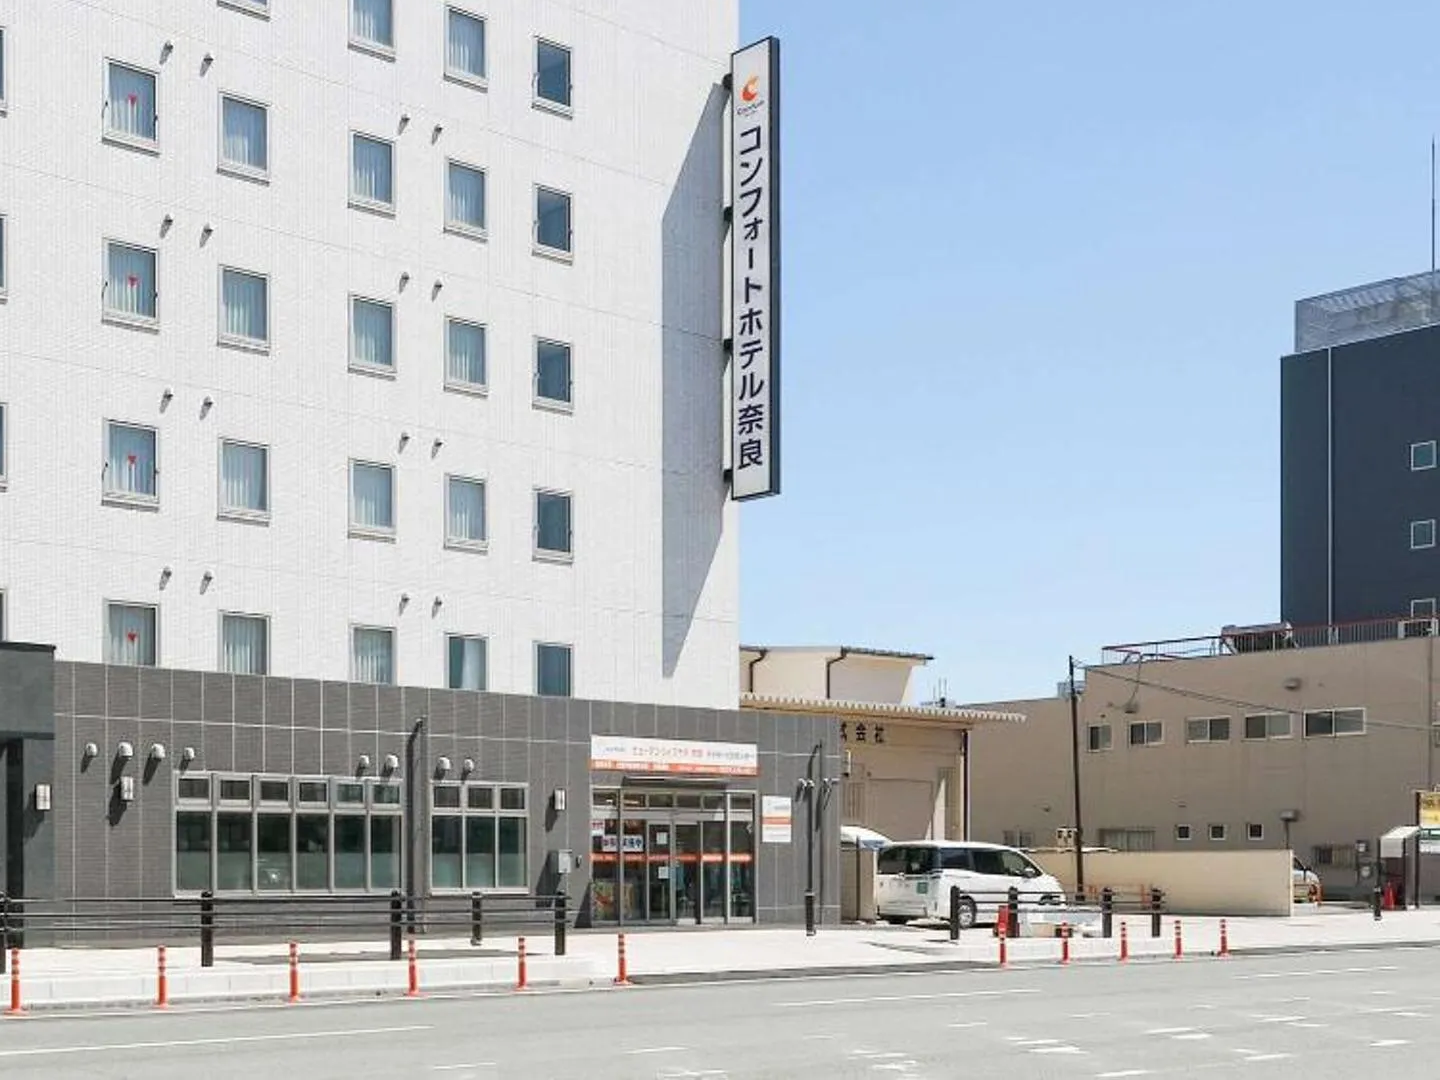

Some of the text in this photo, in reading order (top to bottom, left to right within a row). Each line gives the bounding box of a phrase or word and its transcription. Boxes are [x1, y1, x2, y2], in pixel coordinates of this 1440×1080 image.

[737, 125, 764, 471] コンフォートホテル奈良
